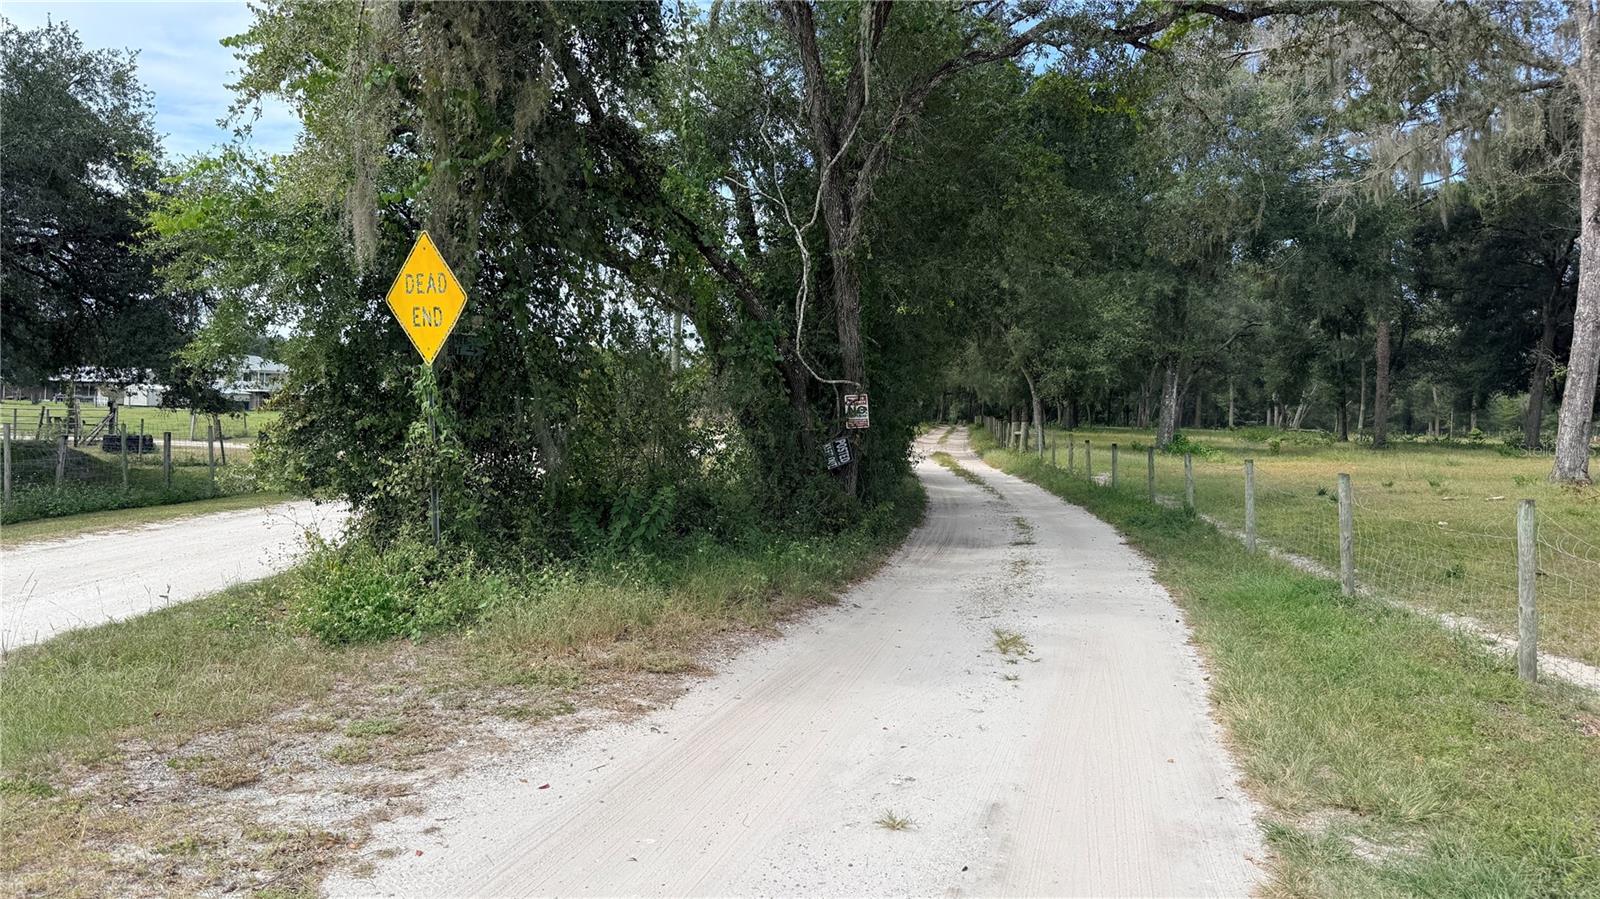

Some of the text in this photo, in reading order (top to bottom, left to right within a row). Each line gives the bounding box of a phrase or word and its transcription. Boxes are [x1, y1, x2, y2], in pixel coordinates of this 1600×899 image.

[405, 272, 447, 294] DEAD
[412, 306, 443, 327] END
[835, 438, 850, 463] POSTED
